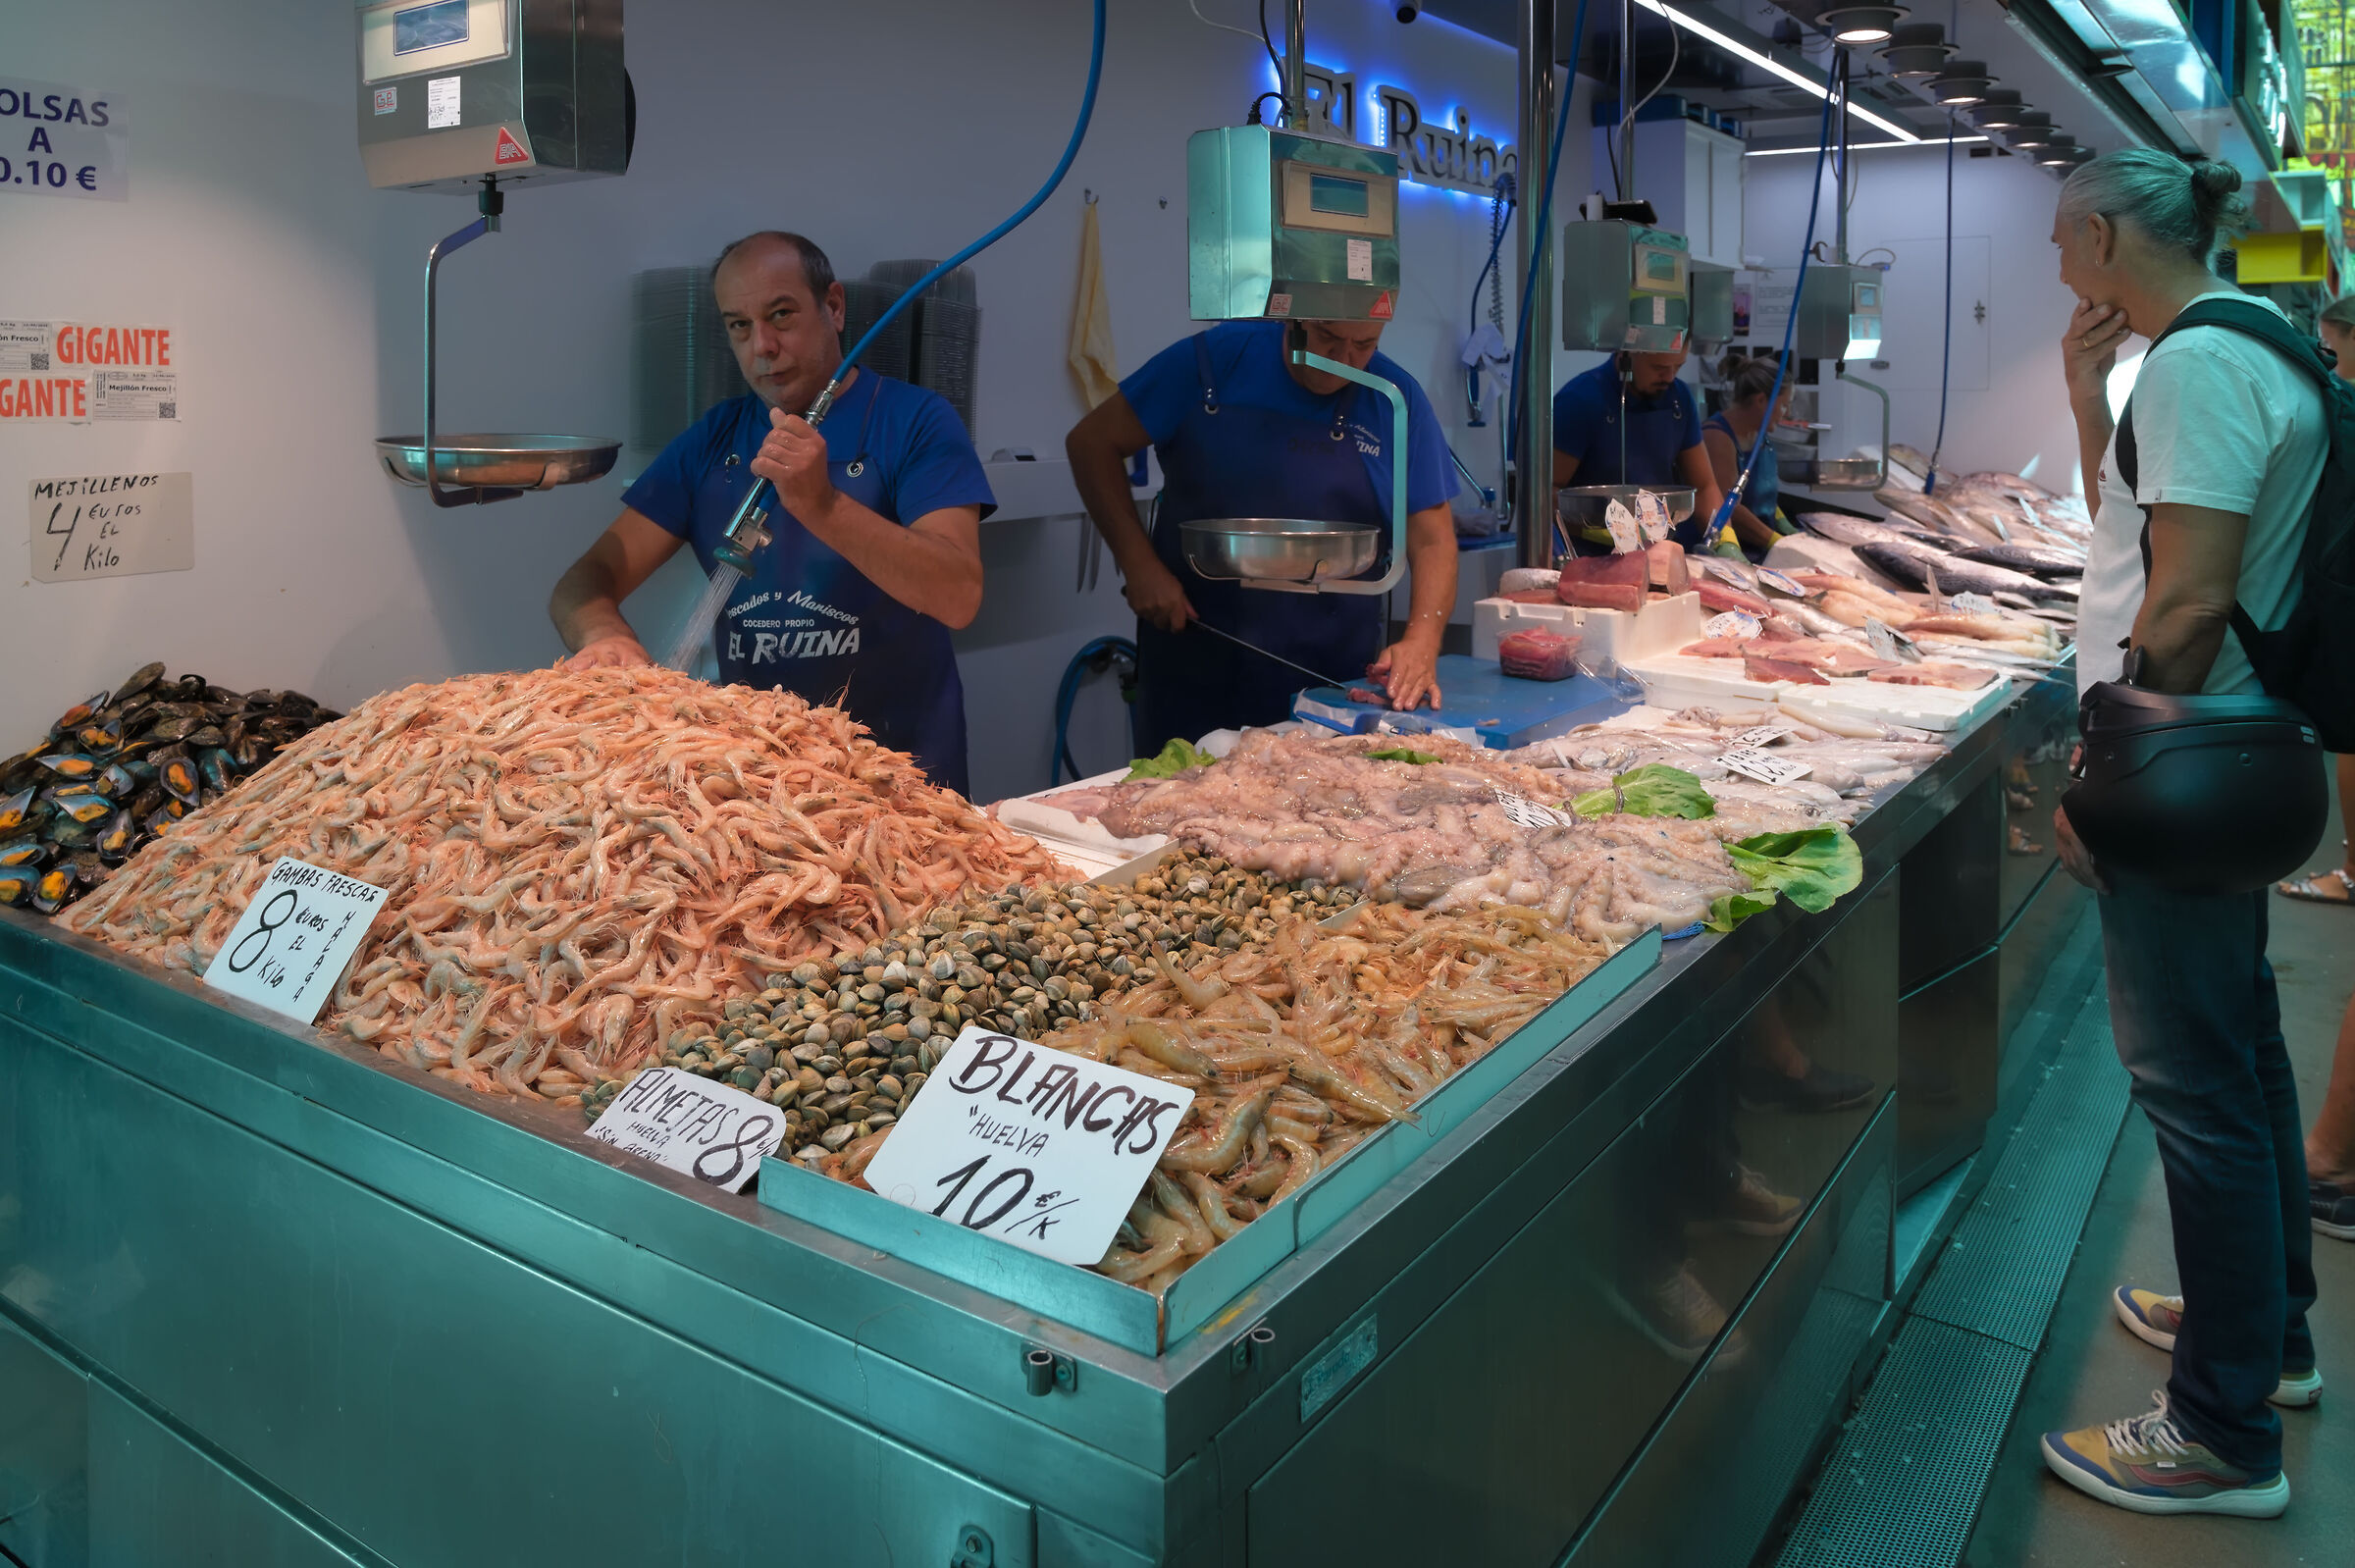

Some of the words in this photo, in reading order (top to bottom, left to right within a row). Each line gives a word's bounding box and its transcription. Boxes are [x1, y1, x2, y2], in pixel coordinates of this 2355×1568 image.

[27, 127, 53, 154] A
[76, 165, 97, 191] €
[56, 326, 171, 366] GIGANTE
[109, 384, 140, 392] Mejillón
[47, 502, 81, 571] 4
[100, 521, 121, 539] EL
[84, 543, 120, 571] Kilo
[743, 619, 781, 628] COCEDERO
[785, 619, 815, 628] PROPIO
[775, 592, 782, 601] y
[787, 590, 860, 625] Mariscos
[728, 631, 745, 660] EL
[752, 627, 861, 665] RUINA
[272, 862, 323, 888] GAMBAS
[322, 874, 379, 903] FRESCAS
[229, 889, 298, 973] 8
[288, 935, 306, 951] EL
[948, 1035, 1179, 1155] BLANCAS
[692, 1115, 774, 1186] 8
[929, 1154, 1035, 1230] 10
